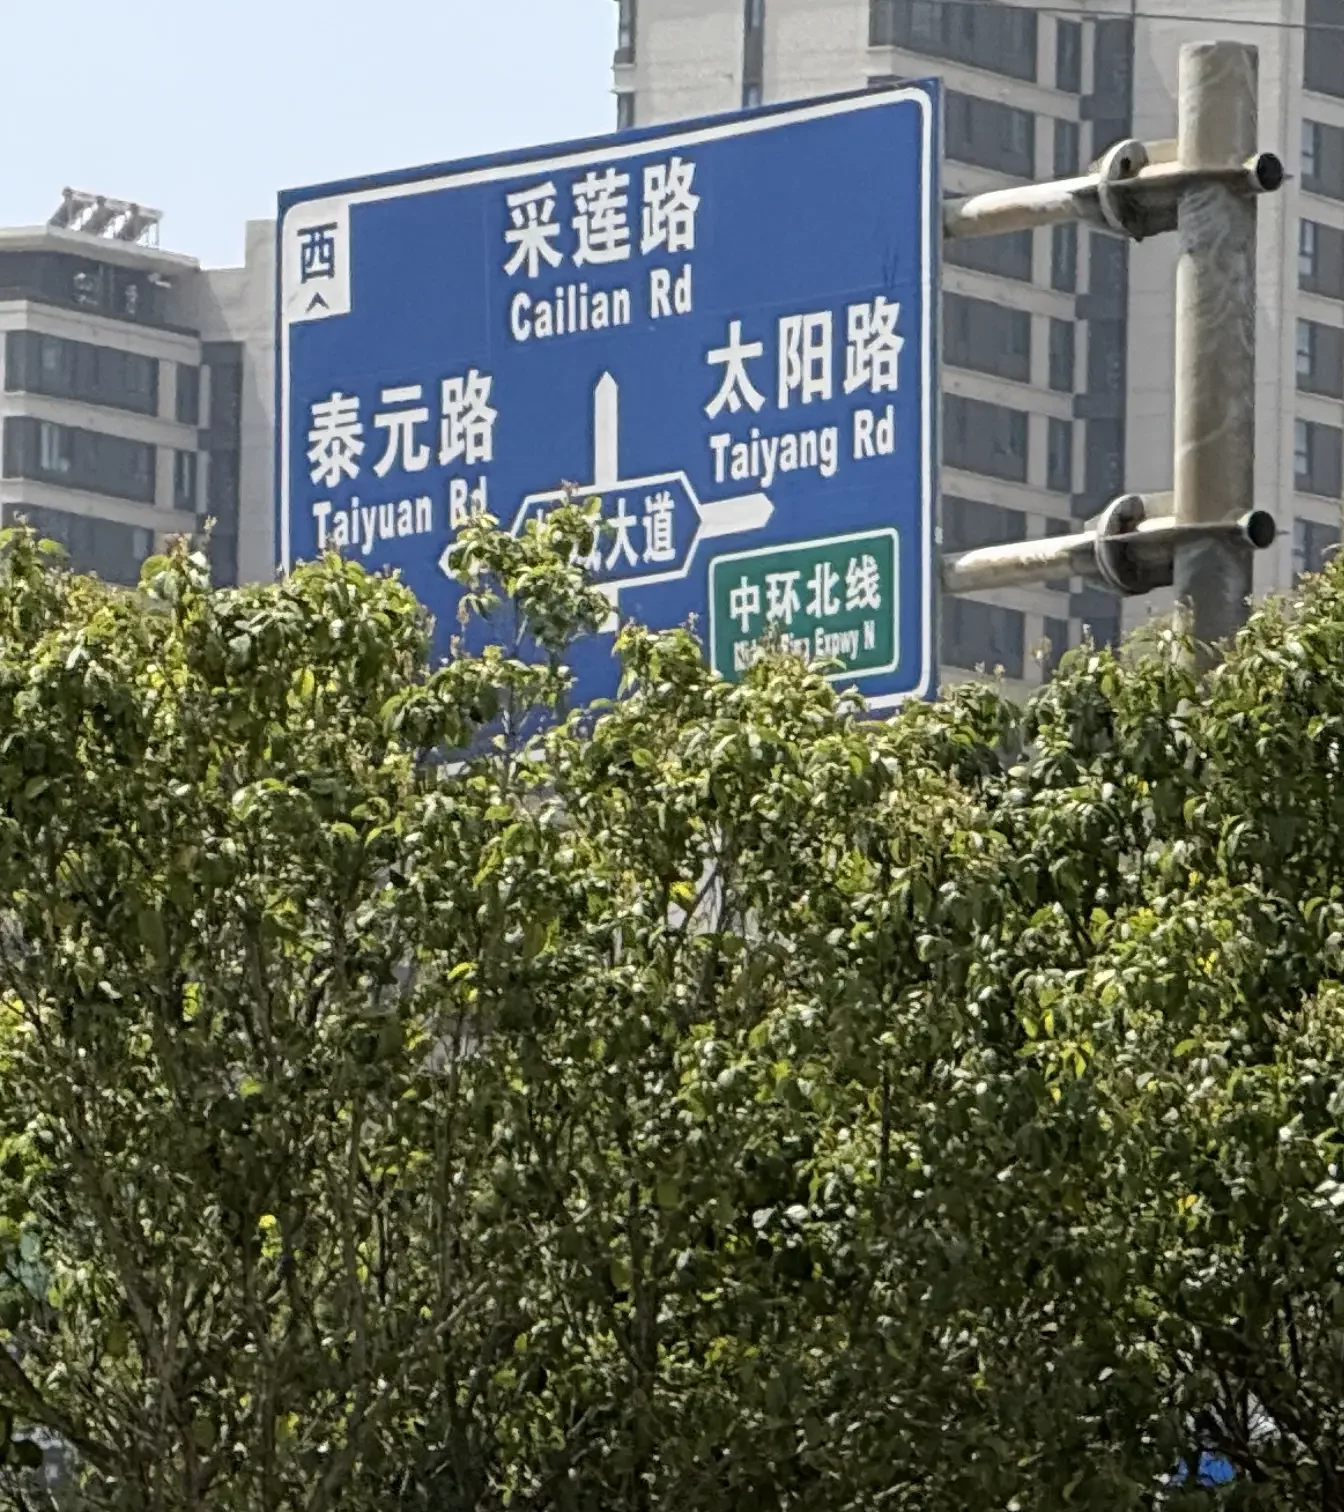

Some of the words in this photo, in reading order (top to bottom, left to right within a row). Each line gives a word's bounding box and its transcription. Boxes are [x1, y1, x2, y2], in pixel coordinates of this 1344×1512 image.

[297, 221, 338, 285] 西
[503, 156, 701, 279] 采莲路
[511, 282, 630, 342] Cailian
[651, 263, 692, 319] Rd
[704, 295, 905, 420] 太阳路
[306, 368, 499, 489] 泰元路
[709, 427, 838, 488] Taiyang
[853, 404, 894, 460] Rd
[312, 496, 432, 556] Taiyuan
[449, 475, 488, 530] Rd
[533, 490, 676, 576] 大道
[730, 554, 882, 633] 中环北线
[863, 620, 875, 650] N
